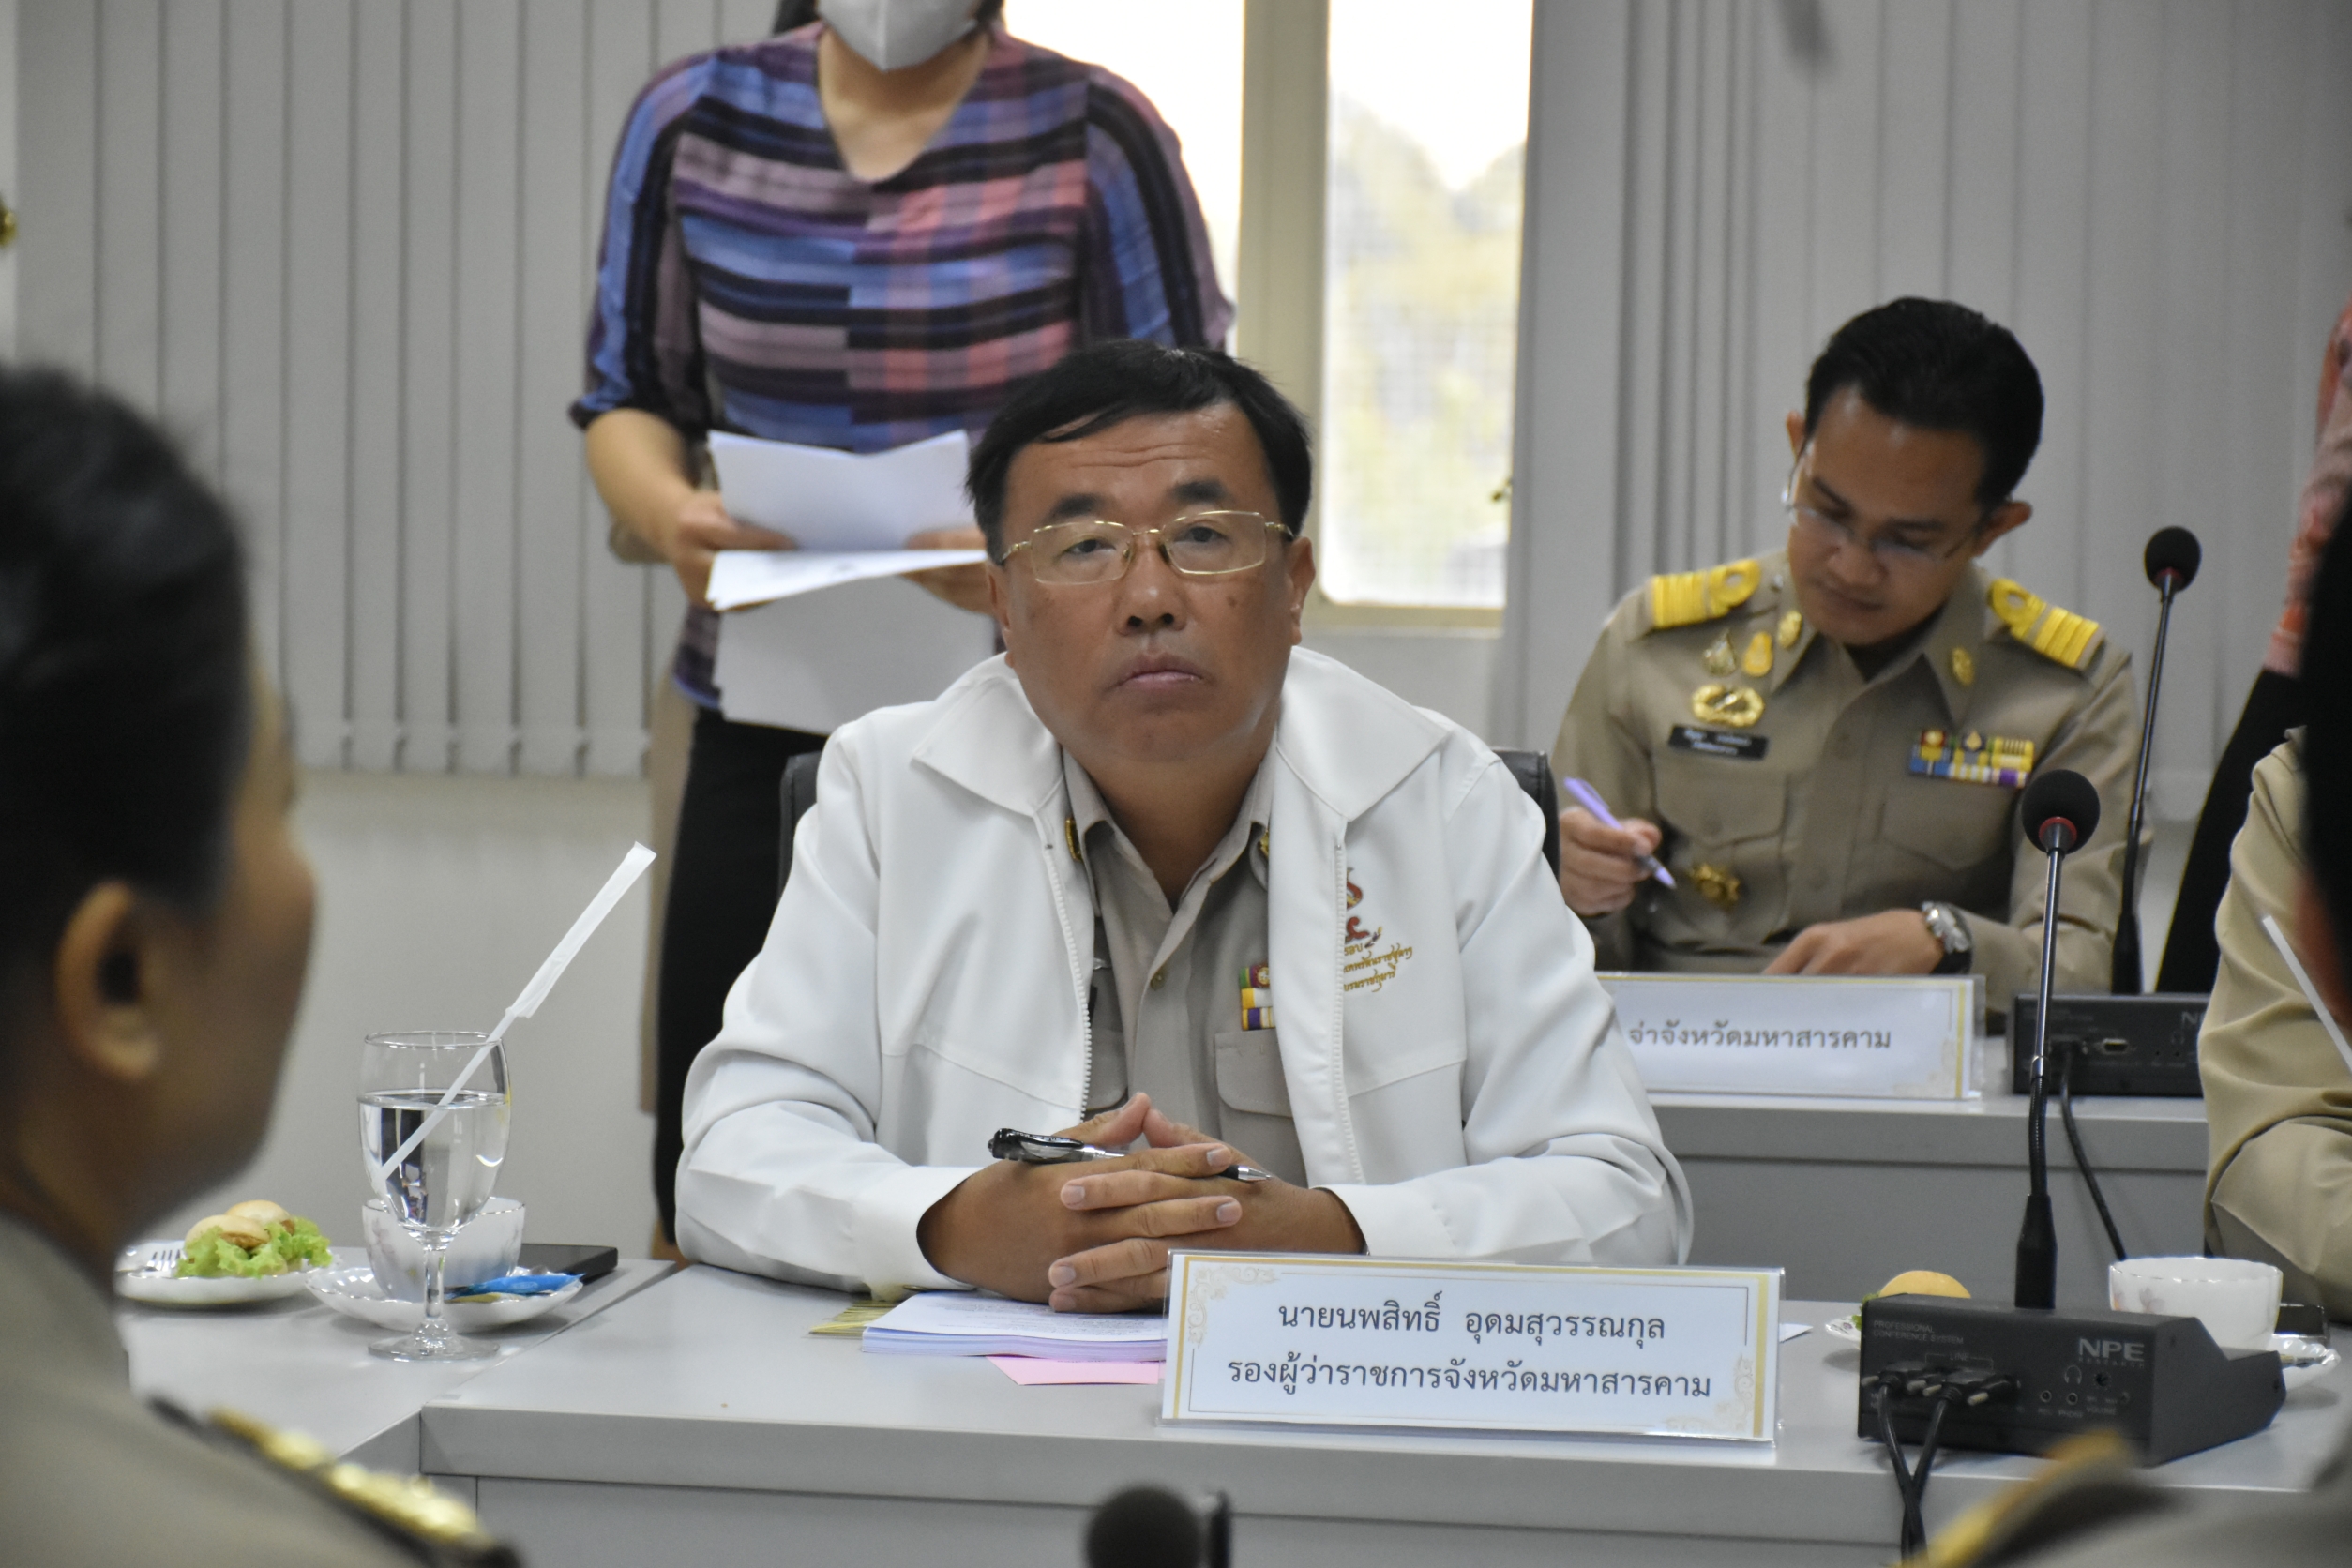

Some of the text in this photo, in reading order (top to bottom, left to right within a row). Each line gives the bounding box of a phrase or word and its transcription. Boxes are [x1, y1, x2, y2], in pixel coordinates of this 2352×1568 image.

[1629, 1019, 1892, 1049] จ่าจังหวัดมหาสารคาม
[1277, 1290, 1666, 1350] นายนพสิทธิ์ อุดมสุวรรณกุล
[1873, 1320, 1935, 1333] PROFESSIONAL
[1873, 1330, 1964, 1344] CONFERENCE SYSTEM
[2078, 1337, 2145, 1362] NPE
[1949, 1353, 1969, 1362] LINE
[1227, 1350, 1711, 1397] รองผู้ว่าราชการจังหวัดมหาสารคาม
